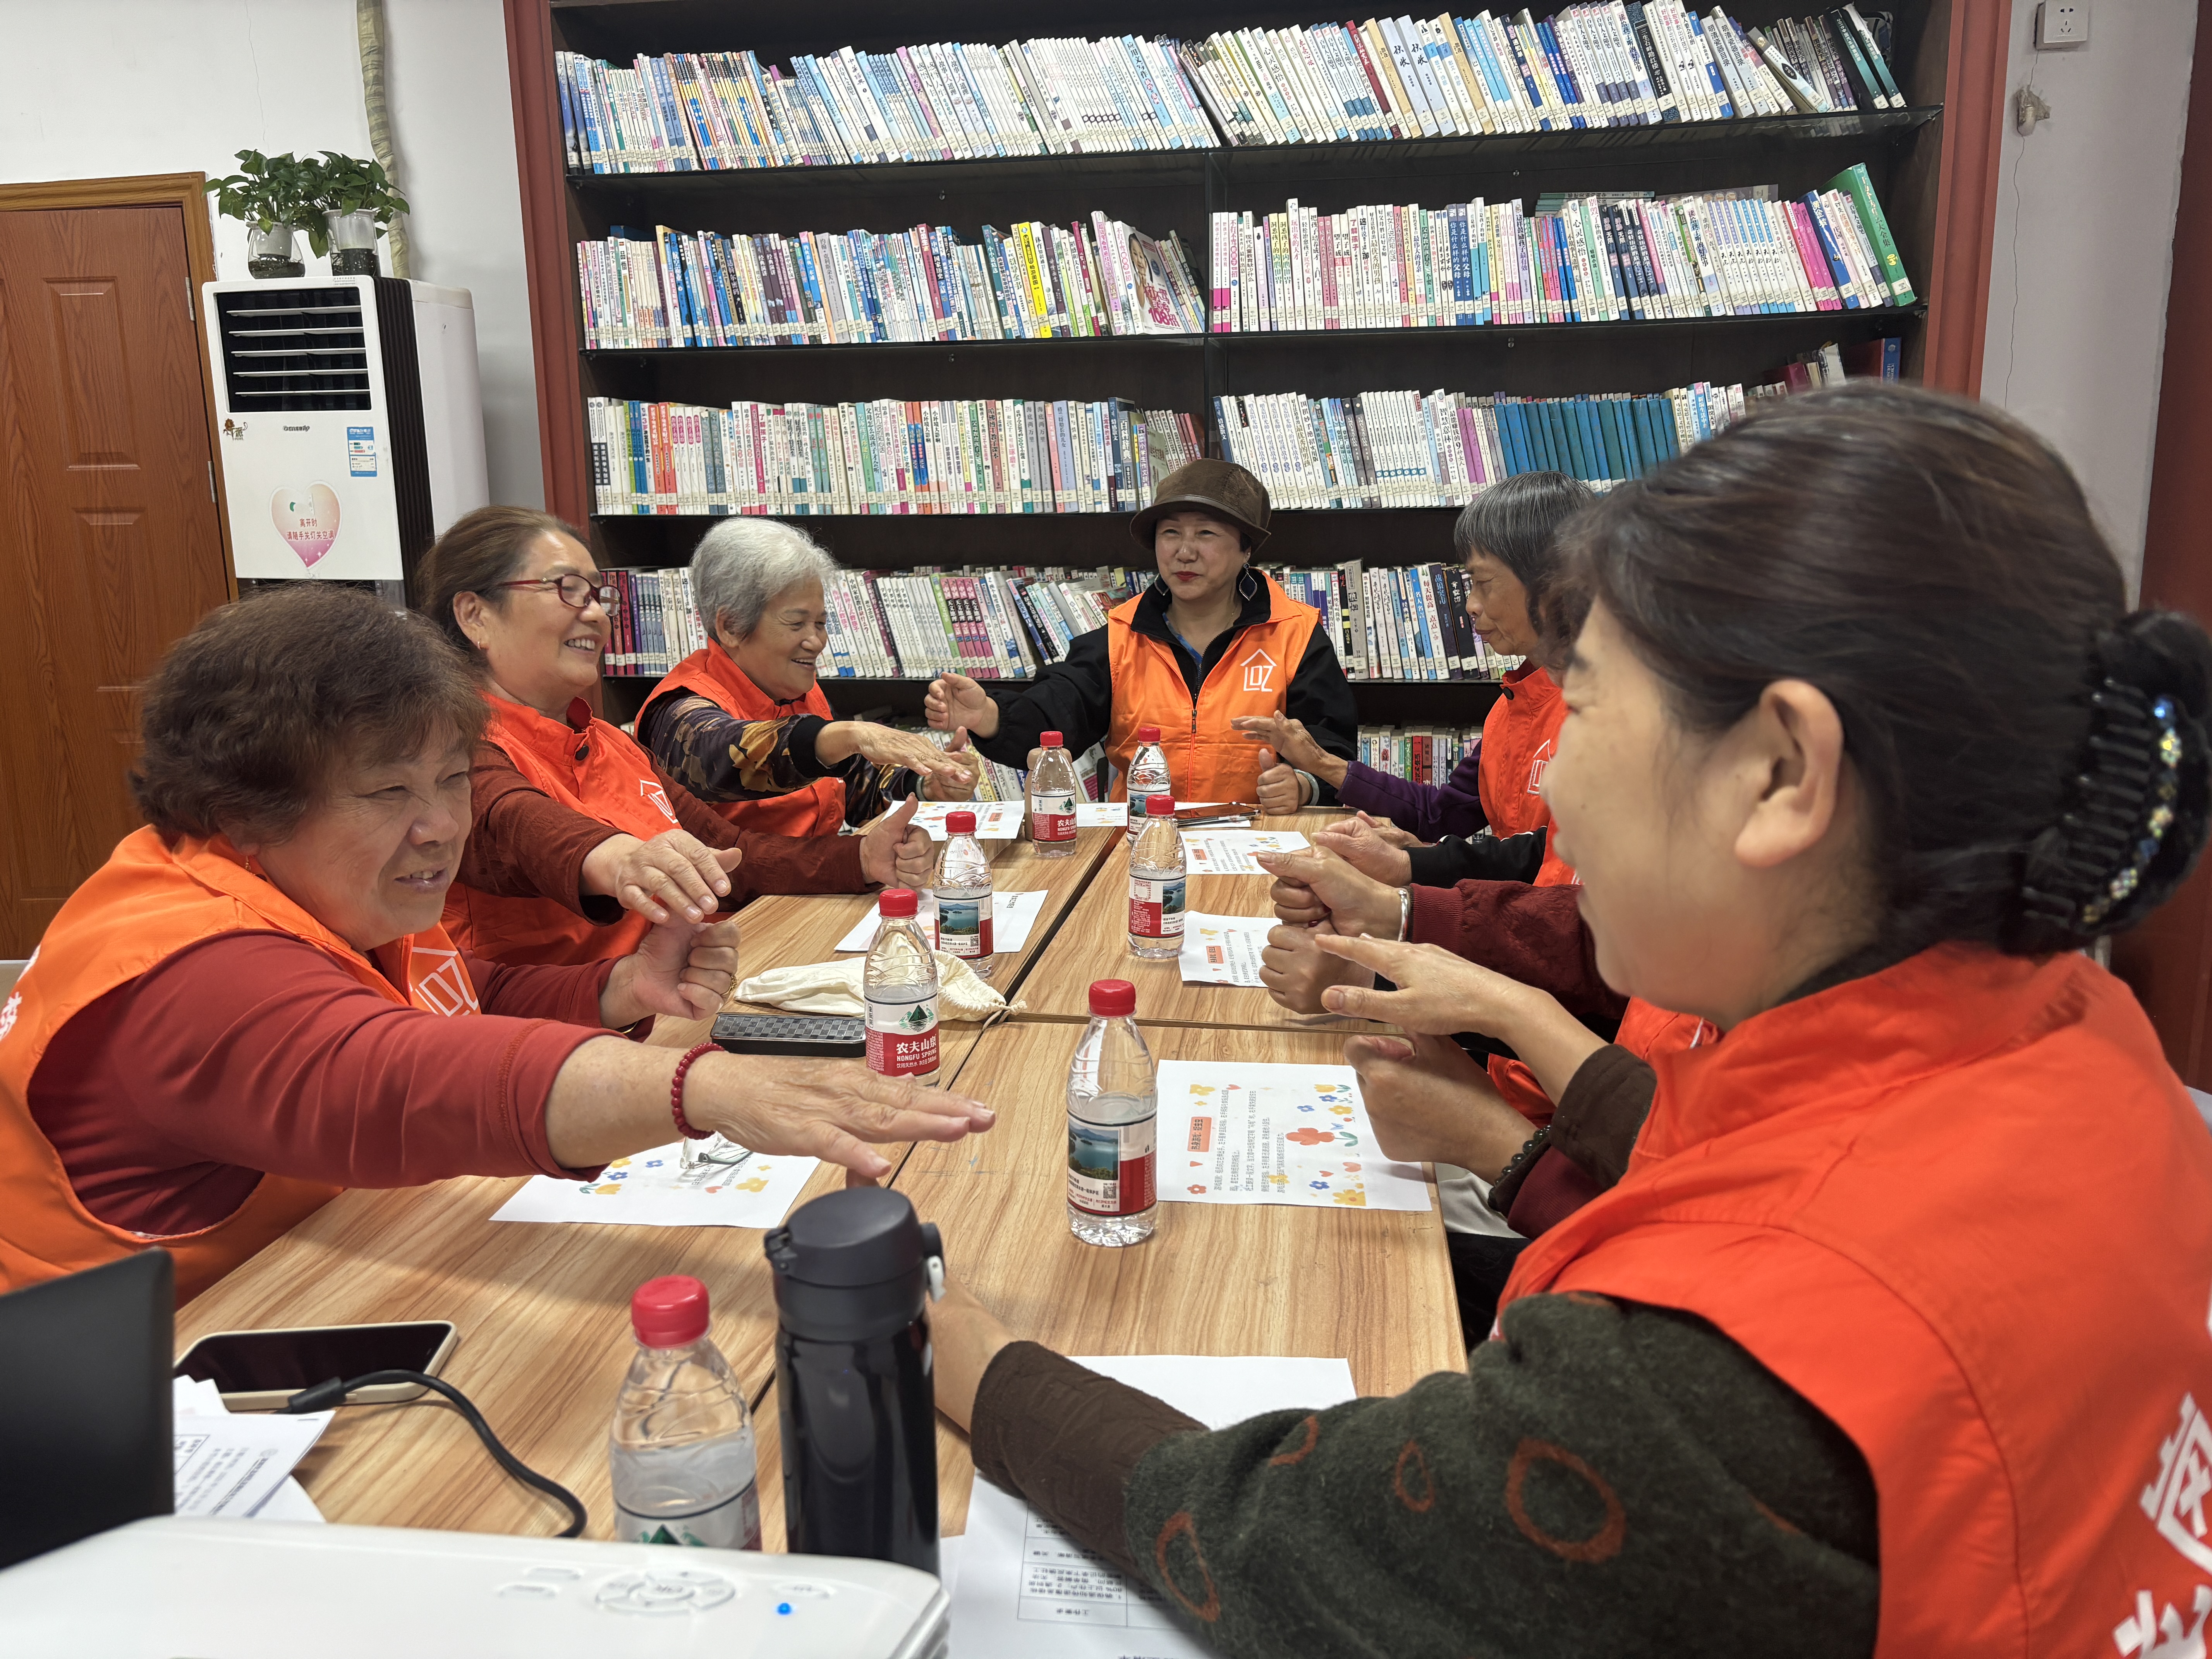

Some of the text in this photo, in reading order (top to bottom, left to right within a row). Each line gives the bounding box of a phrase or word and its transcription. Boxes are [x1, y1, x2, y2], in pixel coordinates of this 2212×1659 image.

[1127, 41, 1147, 78] 应用文写作
[1264, 47, 1284, 82] 心灵感悟
[1394, 45, 1410, 68] 秋收
[1412, 43, 1427, 65] 秋收
[935, 52, 957, 95] 小故事大道理
[948, 52, 969, 95] 小故事大道理
[1291, 220, 1300, 260] 玩出来的天才
[1350, 220, 1359, 251] 了解孩子
[1387, 212, 1396, 261] 和女儿说的知心话
[1450, 222, 1462, 278] 你是什么样的父母
[1459, 222, 1471, 278] 你是什么样的父母
[1573, 220, 1587, 257] 心灵感悟
[1120, 420, 1132, 460] 百科辞典
[1439, 408, 1451, 443] 智慧意林
[1415, 591, 1425, 619] 名人名言
[1424, 580, 1438, 630] 每天提高一点点
[896, 1035, 936, 1054] 农夫山泉
[897, 1048, 936, 1061] NONGFU SPRING
